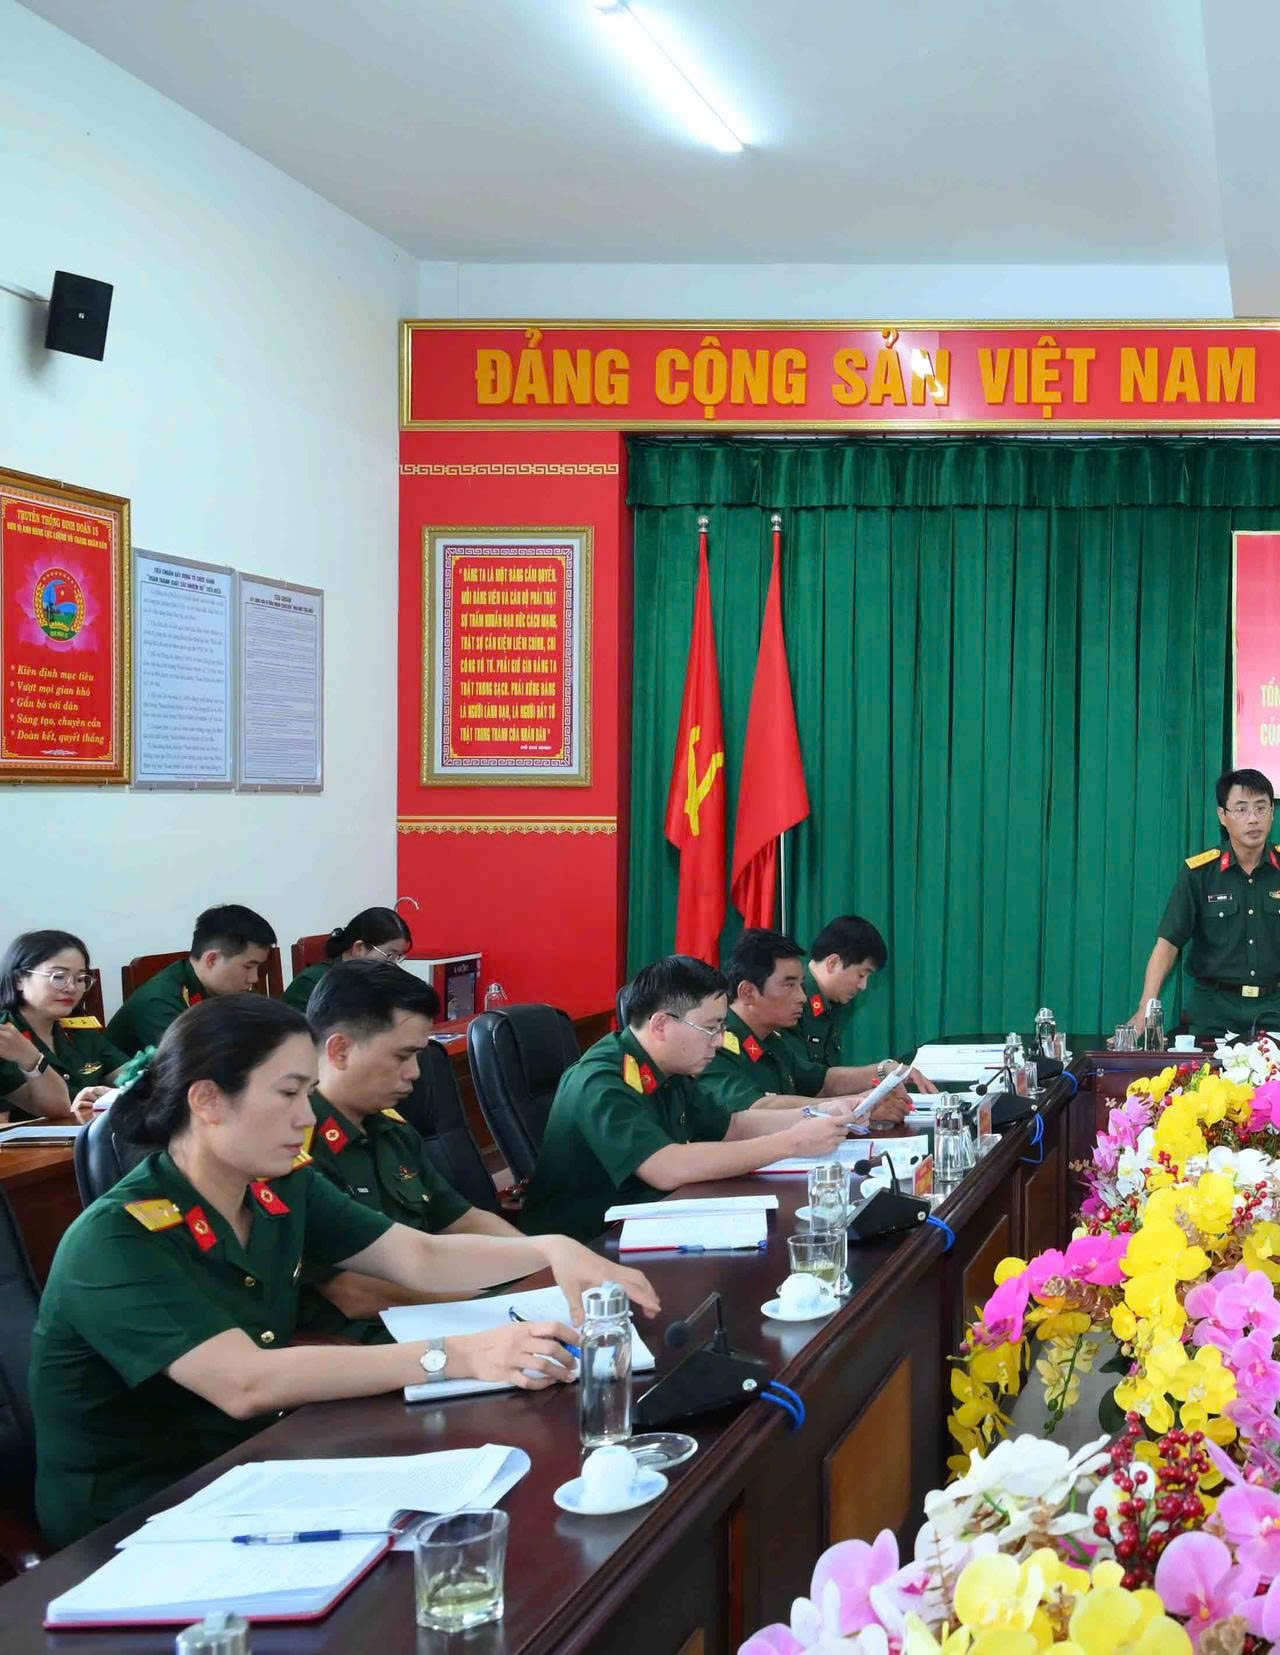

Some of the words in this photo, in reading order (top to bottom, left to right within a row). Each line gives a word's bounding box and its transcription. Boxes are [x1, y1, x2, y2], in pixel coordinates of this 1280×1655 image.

[476, 328, 630, 405] ĐẢNG
[655, 335, 806, 418] CỘNG
[833, 328, 950, 405] SẢN
[978, 336, 1096, 418] VIỆT
[1121, 347, 1255, 405] NAM
